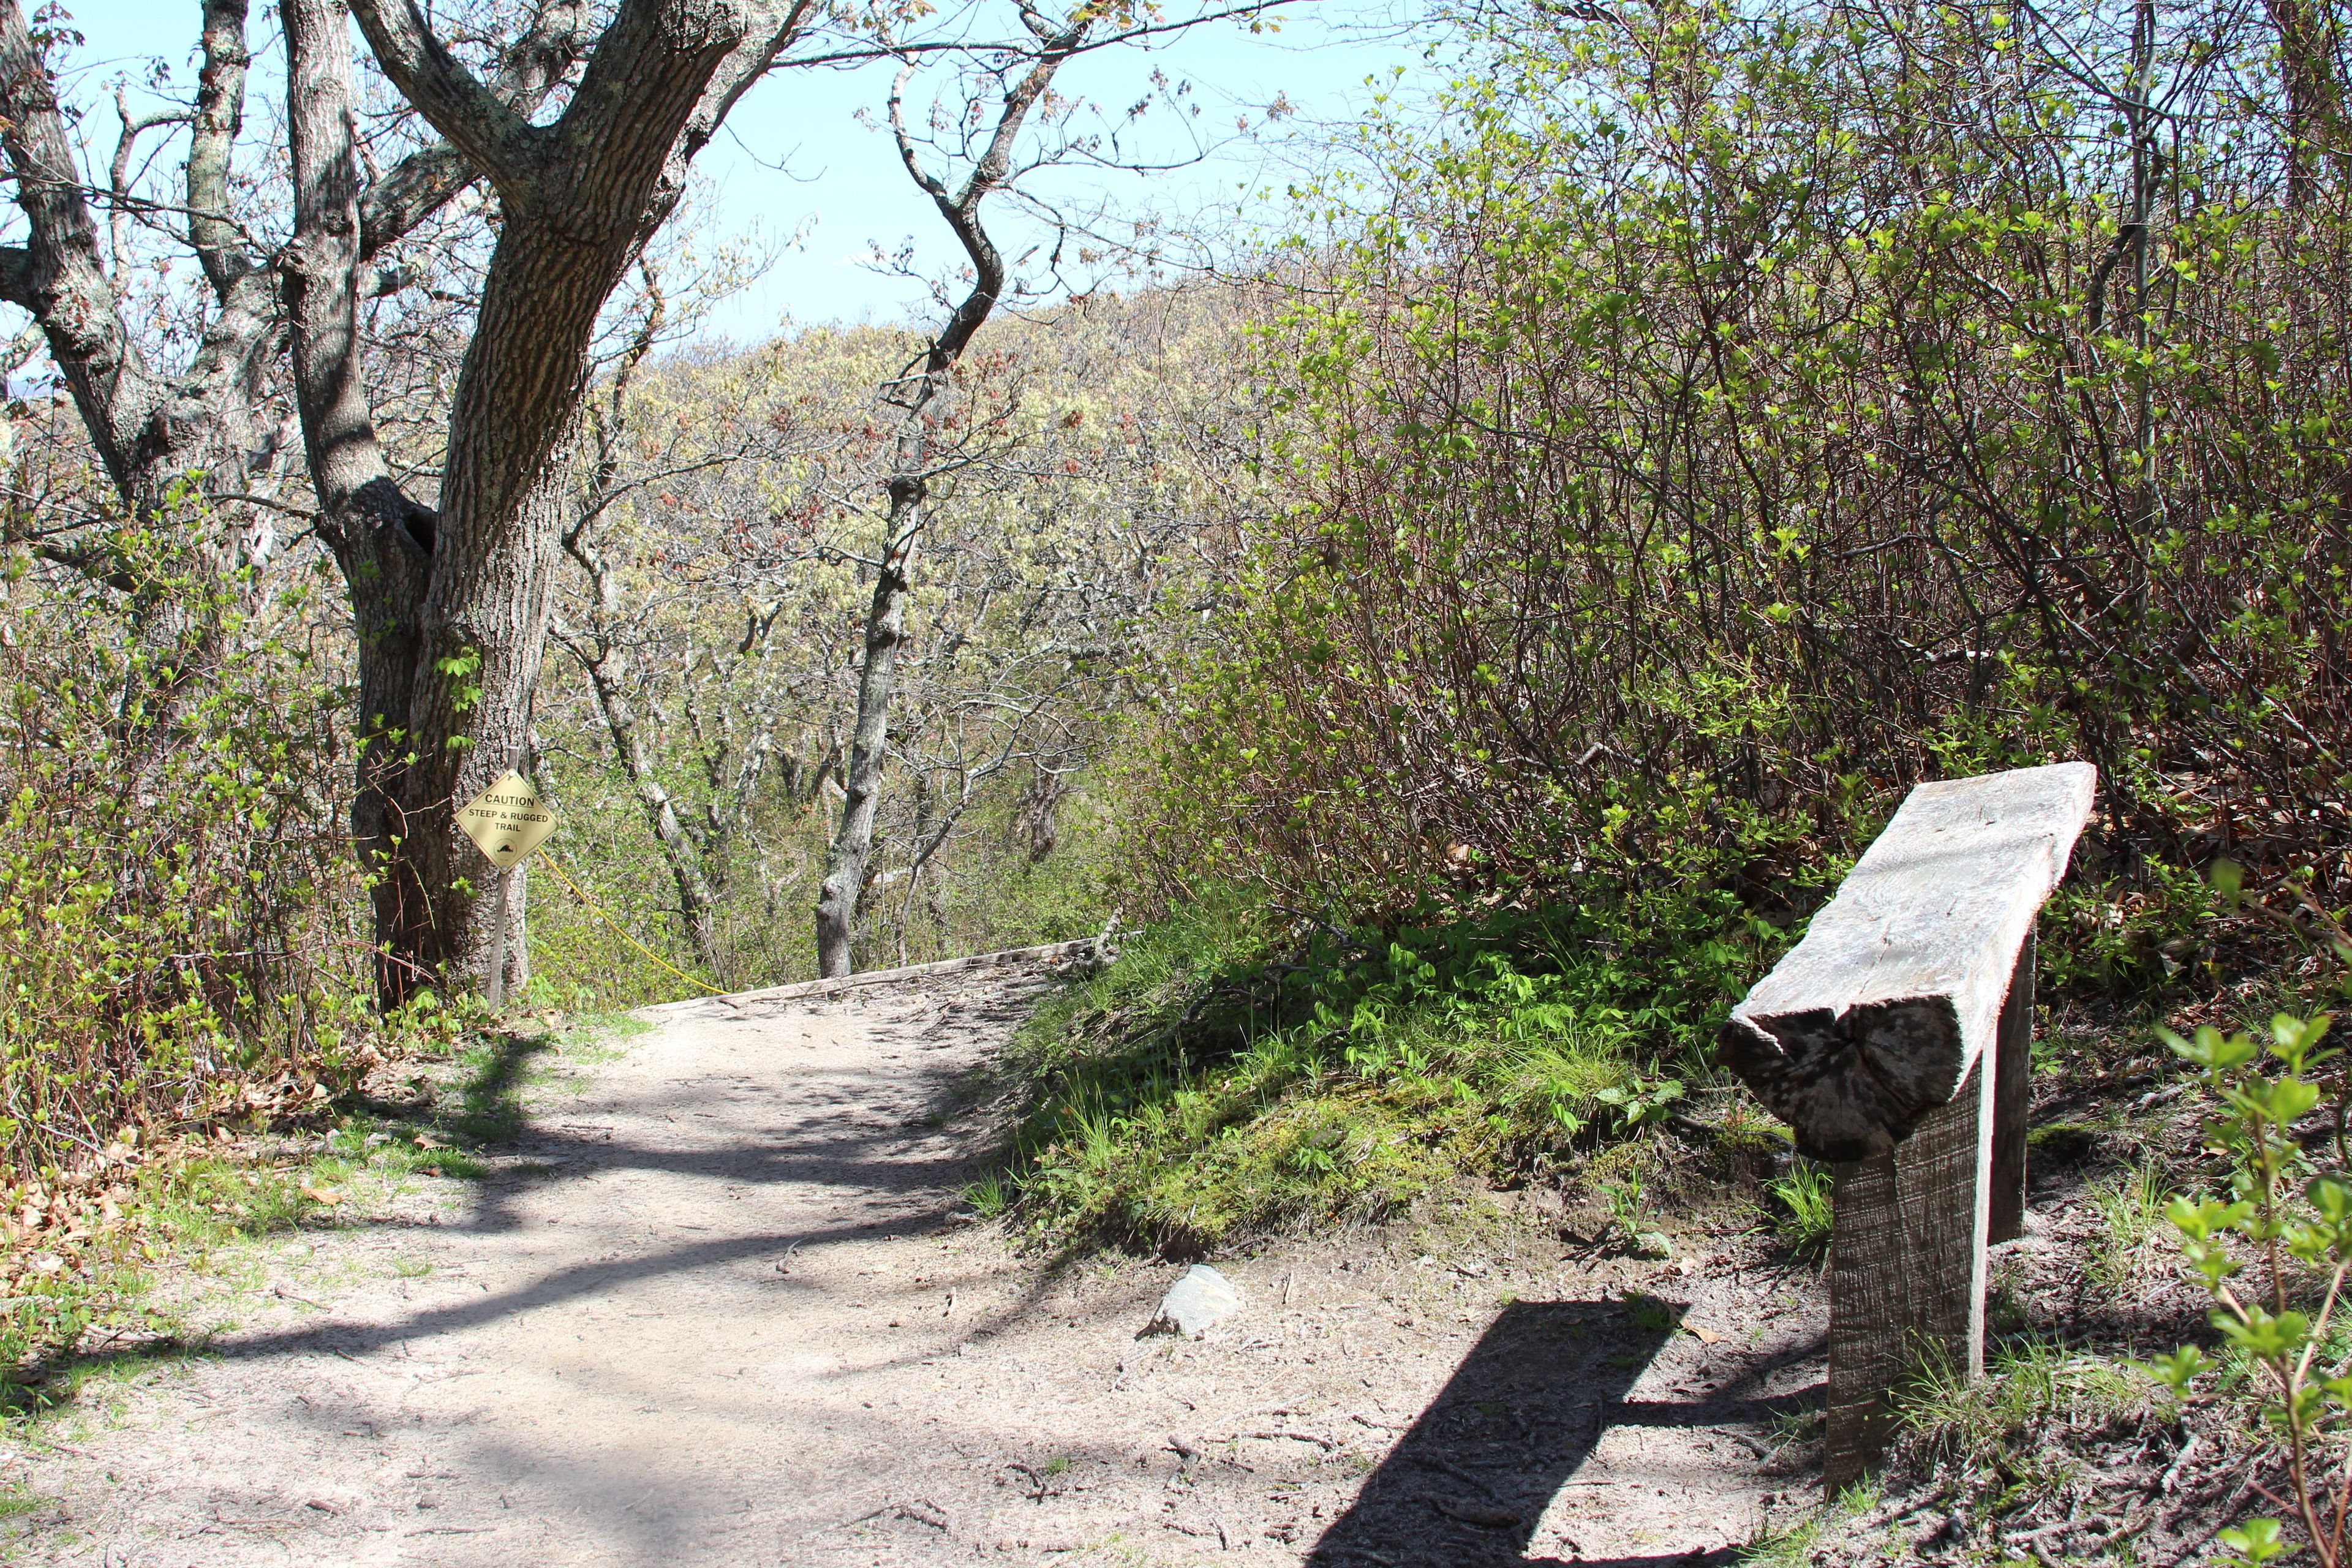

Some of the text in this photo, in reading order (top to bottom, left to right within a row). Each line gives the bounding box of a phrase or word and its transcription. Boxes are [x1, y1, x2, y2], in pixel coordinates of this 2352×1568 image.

[485, 794, 534, 807] CAUTION
[469, 809, 497, 818] STEEP
[511, 813, 548, 823] RUGGED
[495, 823, 521, 832] TRAIL
